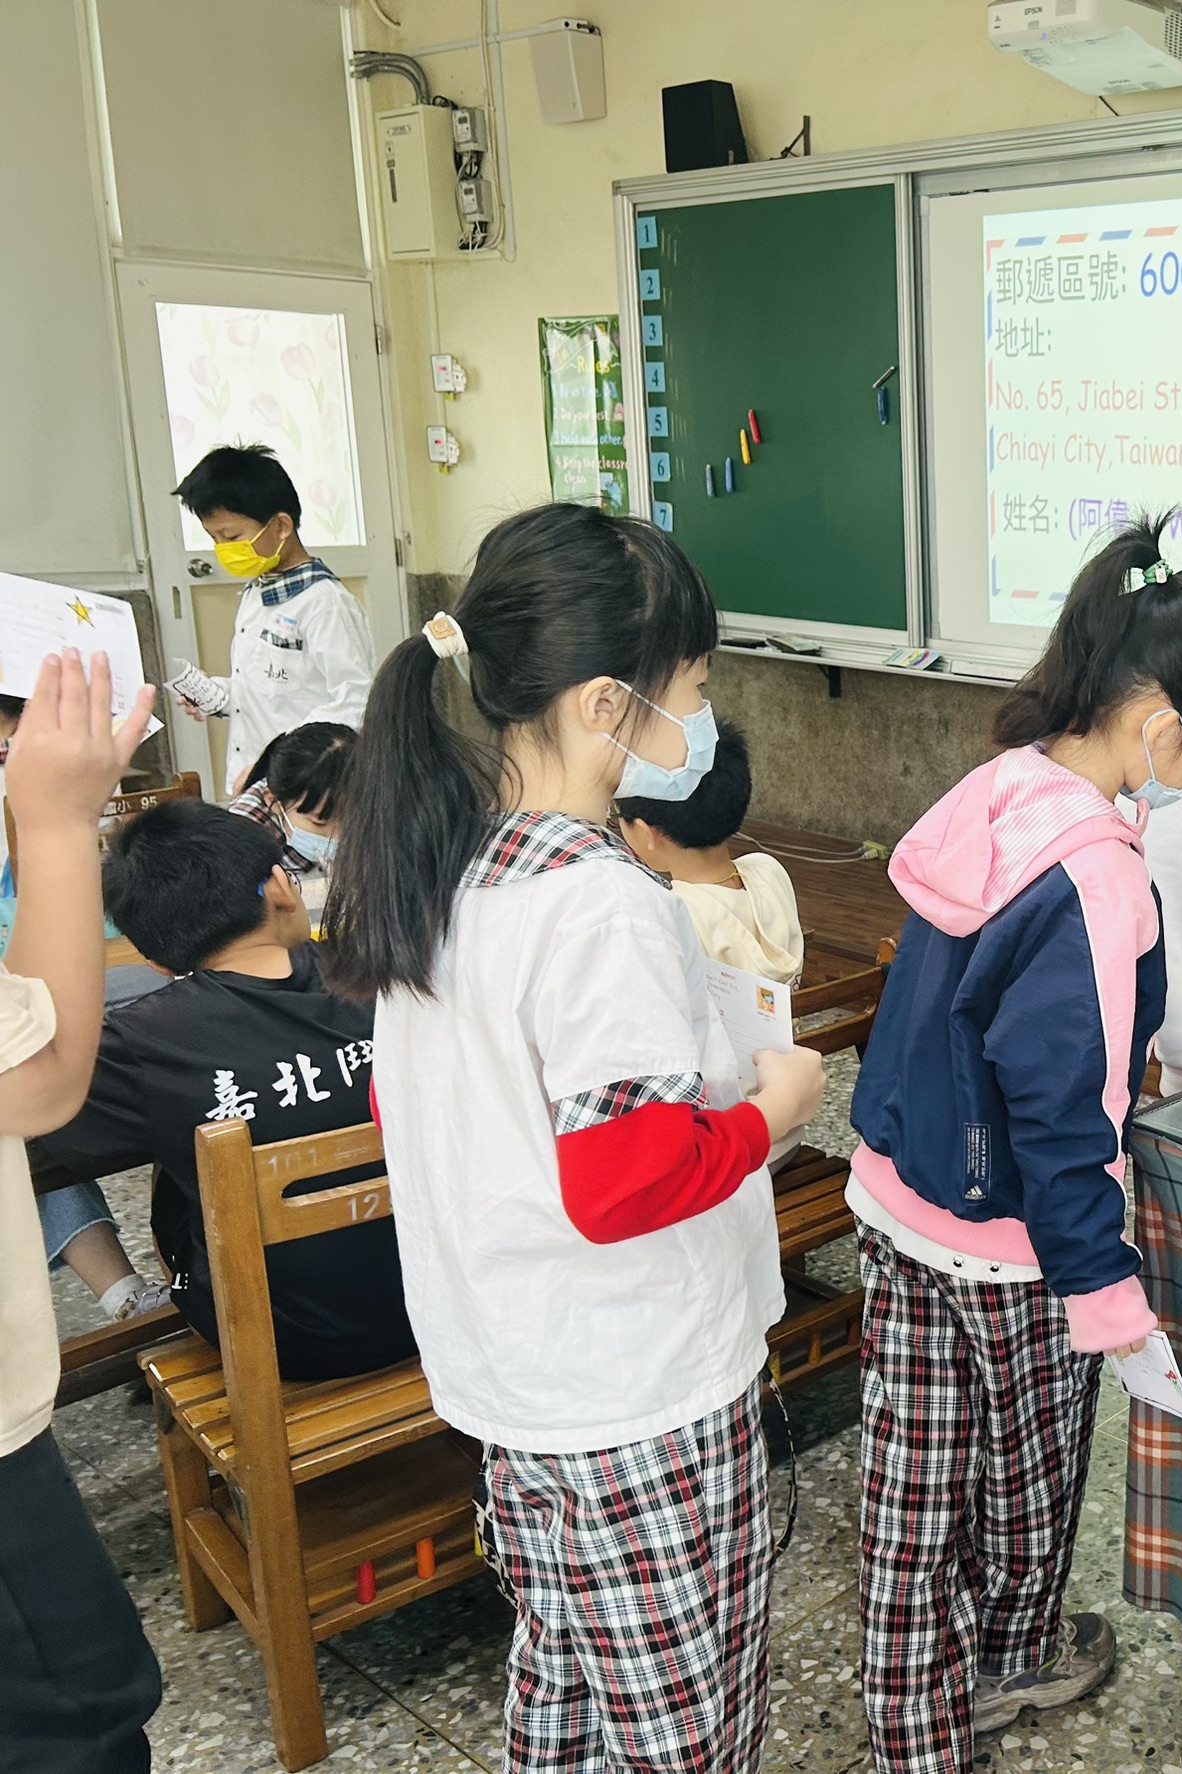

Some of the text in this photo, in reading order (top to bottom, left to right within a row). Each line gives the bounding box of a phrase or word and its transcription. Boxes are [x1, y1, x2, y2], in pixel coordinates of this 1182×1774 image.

[1024, 6, 1043, 16] EPSON
[644, 224, 650, 243] 1
[646, 276, 654, 295] 2
[996, 251, 1127, 305] 郵遞區號:
[649, 322, 657, 341] 3
[995, 317, 1052, 357] 地址:
[577, 355, 611, 374] Rues
[651, 369, 659, 387] 4
[996, 381, 1029, 411] No.
[1036, 380, 1071, 415] 65,
[1078, 379, 1145, 412] Jiabei
[655, 414, 662, 431] 5
[996, 431, 1056, 471] Chiayi
[657, 459, 665, 477] 6
[660, 509, 667, 526] 7
[1003, 493, 1058, 535] 姓名:
[140, 796, 157, 810] 95
